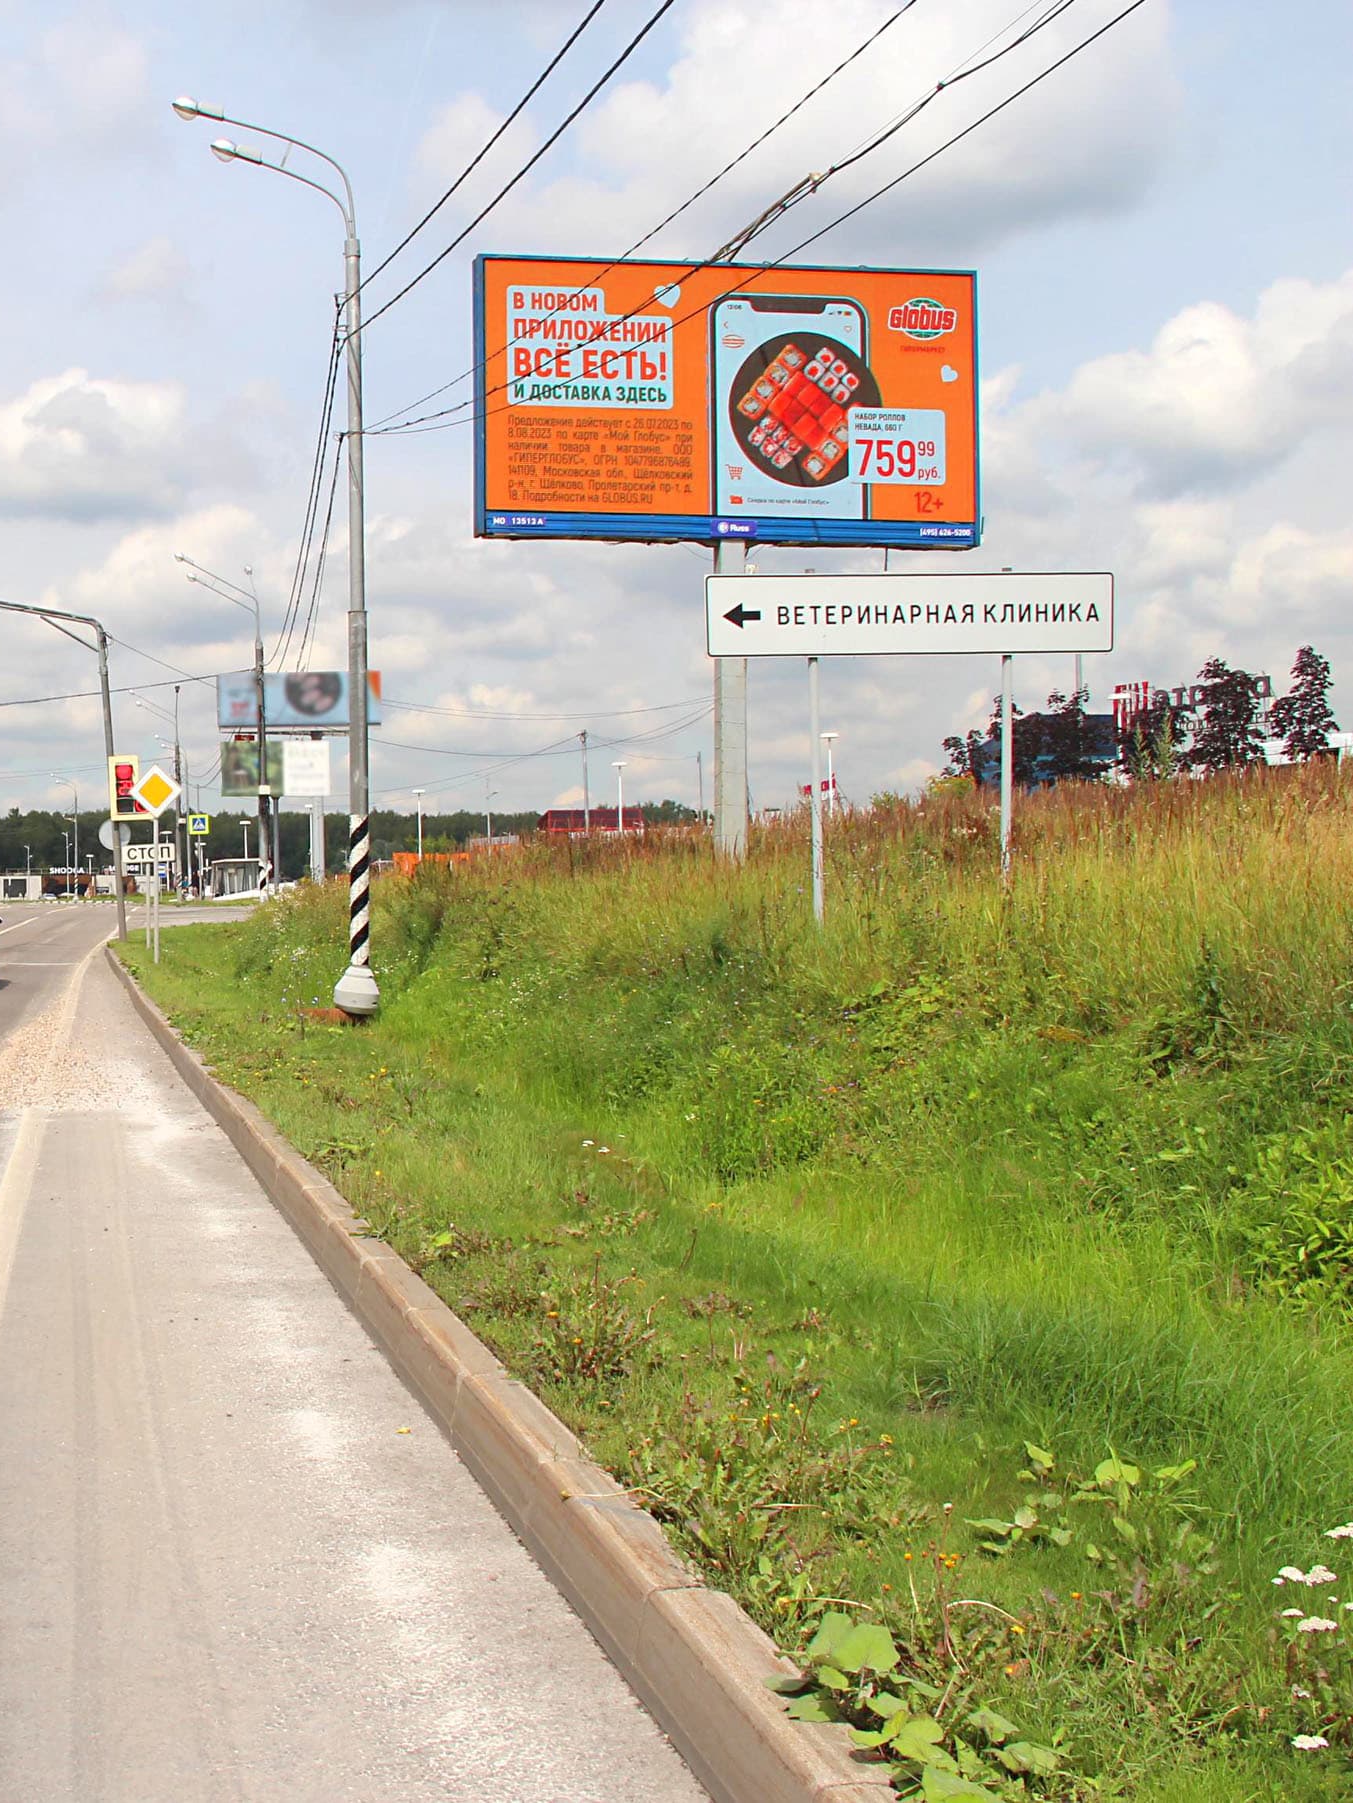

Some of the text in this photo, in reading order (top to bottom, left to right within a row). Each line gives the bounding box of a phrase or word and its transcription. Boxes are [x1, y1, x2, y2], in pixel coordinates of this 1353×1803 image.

[513, 292, 597, 312] В НОВОМ
[513, 318, 666, 343] ПРИЛОЖЕНИИ
[514, 342, 666, 381] ВСЁ ЕСТЬ!
[514, 384, 667, 405] И ДОСТАВКА ЗДЕСЬ
[508, 414, 573, 429] Предложение
[575, 417, 622, 431] действует
[625, 420, 630, 428] с
[854, 413, 877, 421] НАБОР
[556, 430, 567, 439] по
[573, 431, 599, 441] карте
[918, 441, 935, 456] 99
[594, 454, 618, 465] ОГРН
[855, 439, 916, 478] 759
[543, 466, 600, 477] Московская
[918, 467, 941, 480] руб.
[914, 491, 944, 513] 12+
[777, 602, 1100, 625] ВЕТЕРИНАРНАЯ КЛИНИКА
